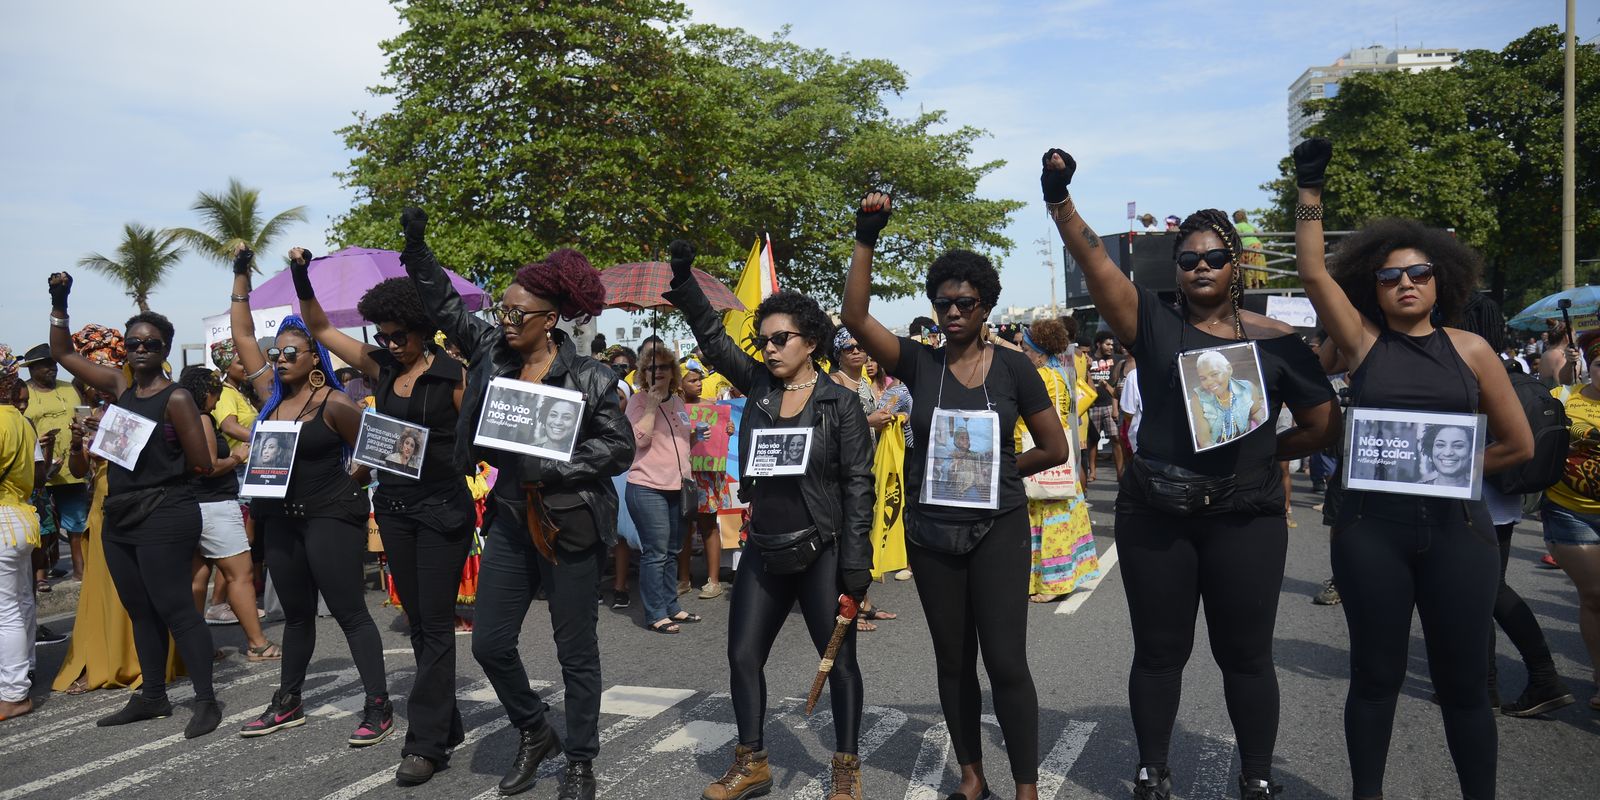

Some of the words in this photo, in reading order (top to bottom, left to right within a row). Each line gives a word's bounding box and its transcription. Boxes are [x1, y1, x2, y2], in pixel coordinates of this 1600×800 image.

[490, 400, 510, 411] Não
[512, 405, 530, 414] vão
[488, 410, 505, 420] nos
[507, 413, 534, 425] calar.
[1359, 436, 1383, 446] Não
[1386, 437, 1409, 448] vão
[1358, 448, 1379, 457] nos
[1382, 448, 1416, 460] calar.
